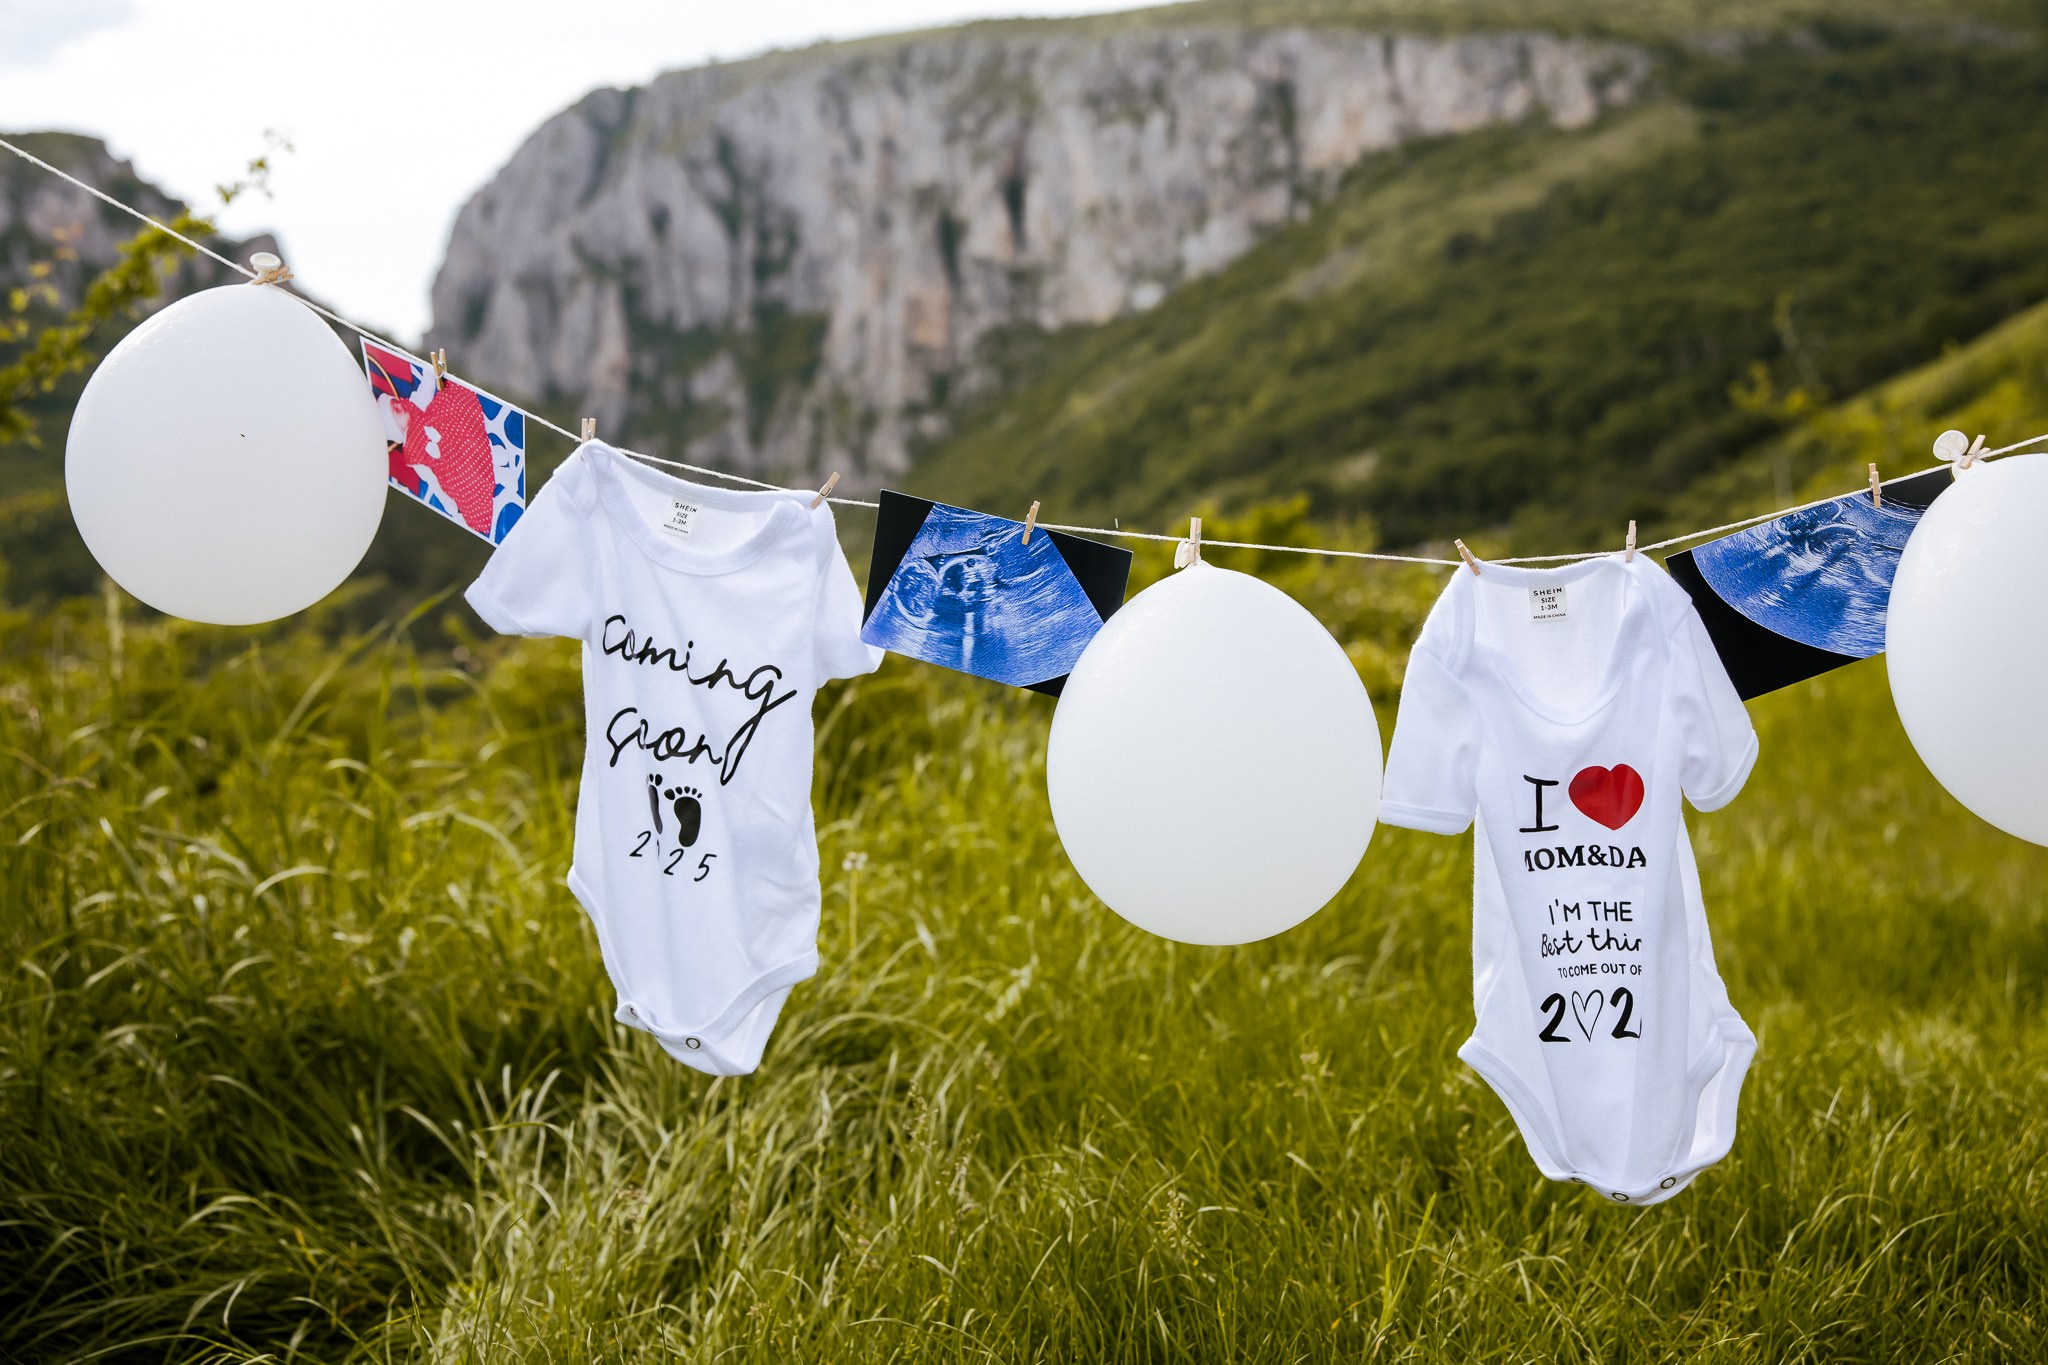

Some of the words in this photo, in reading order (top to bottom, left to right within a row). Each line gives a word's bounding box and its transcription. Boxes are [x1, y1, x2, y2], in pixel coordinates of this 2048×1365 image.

[674, 502, 698, 513] SHEIN
[676, 511, 689, 519] SIZE
[1533, 587, 1563, 597] SHEIN
[1541, 596, 1556, 604] SIZE
[1518, 774, 1560, 833] I
[629, 830, 717, 882] 225
[1548, 898, 1581, 926] I'M
[1587, 901, 1633, 922] THE
[1541, 929, 1583, 959] Best
[1558, 967, 1568, 979] TO
[1568, 963, 1597, 977] COME
[1600, 963, 1627, 976] OUT
